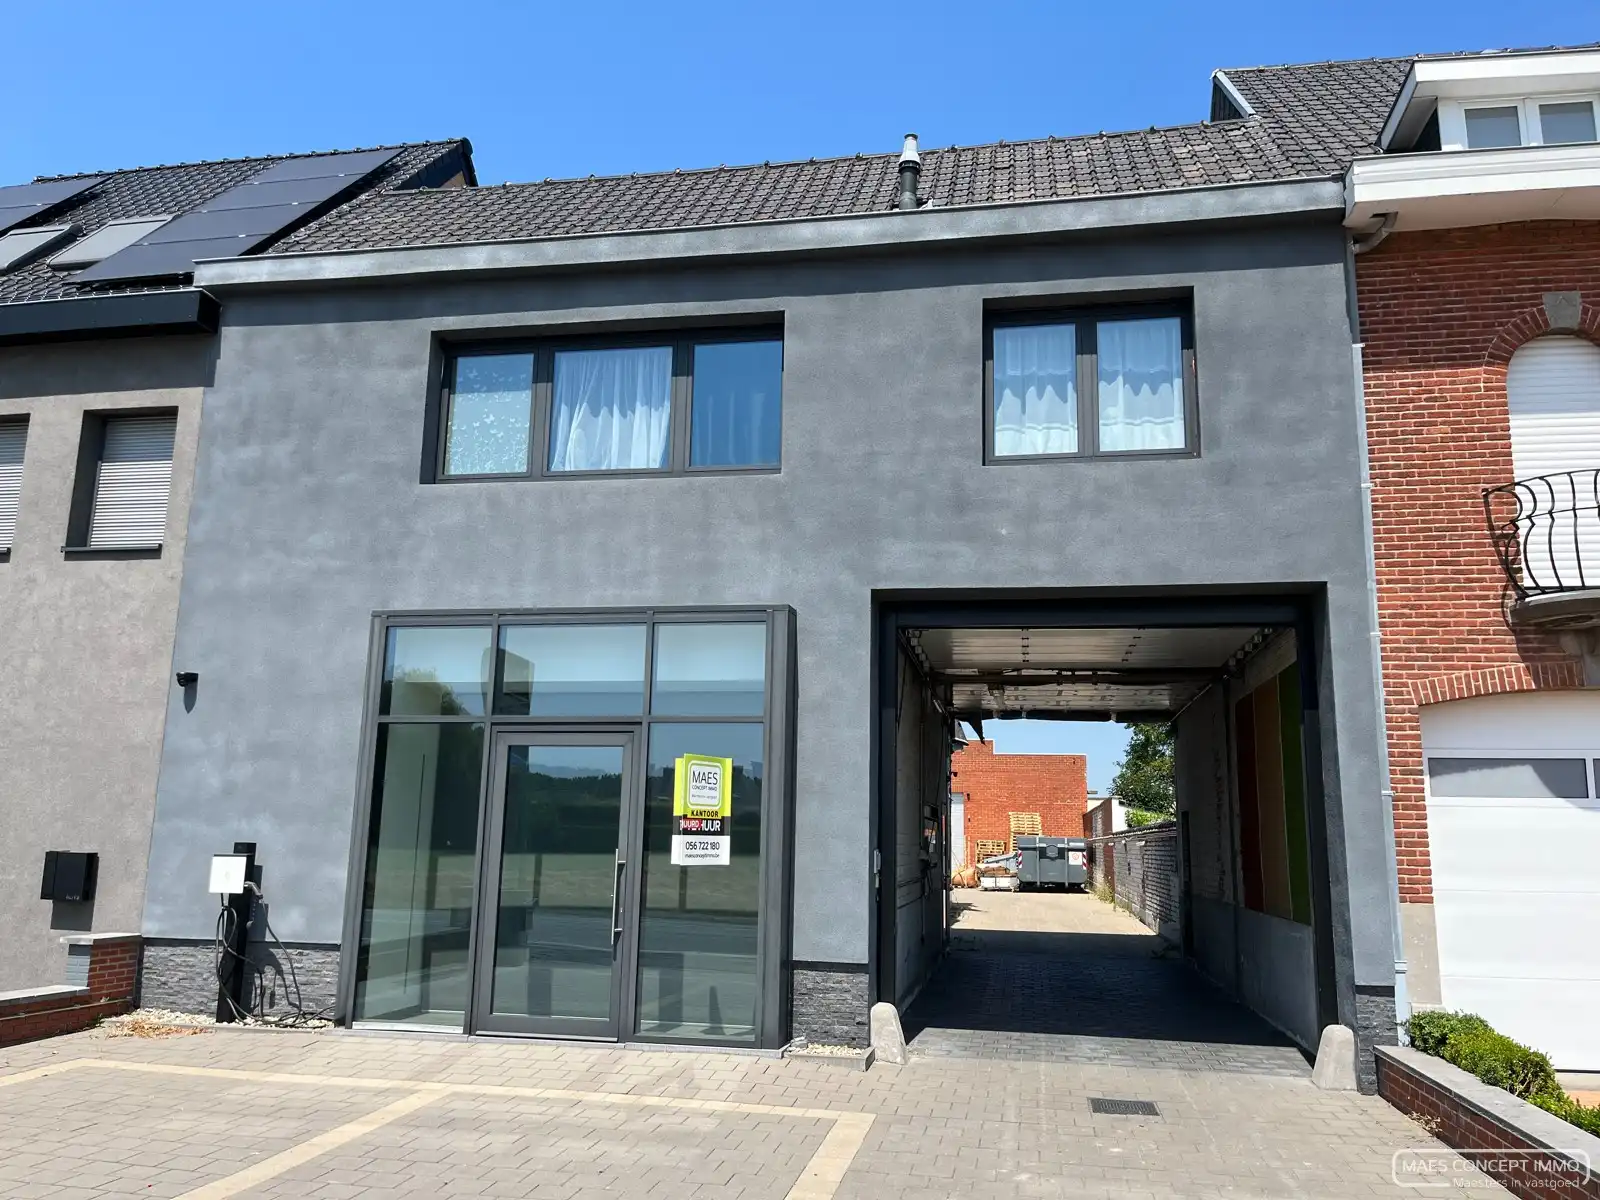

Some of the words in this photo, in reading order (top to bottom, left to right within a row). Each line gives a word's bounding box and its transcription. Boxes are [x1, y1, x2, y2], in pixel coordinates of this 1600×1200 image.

[692, 770, 718, 785] MAES
[685, 841, 698, 851] 056
[698, 841, 709, 851] 722
[709, 841, 720, 851] 180
